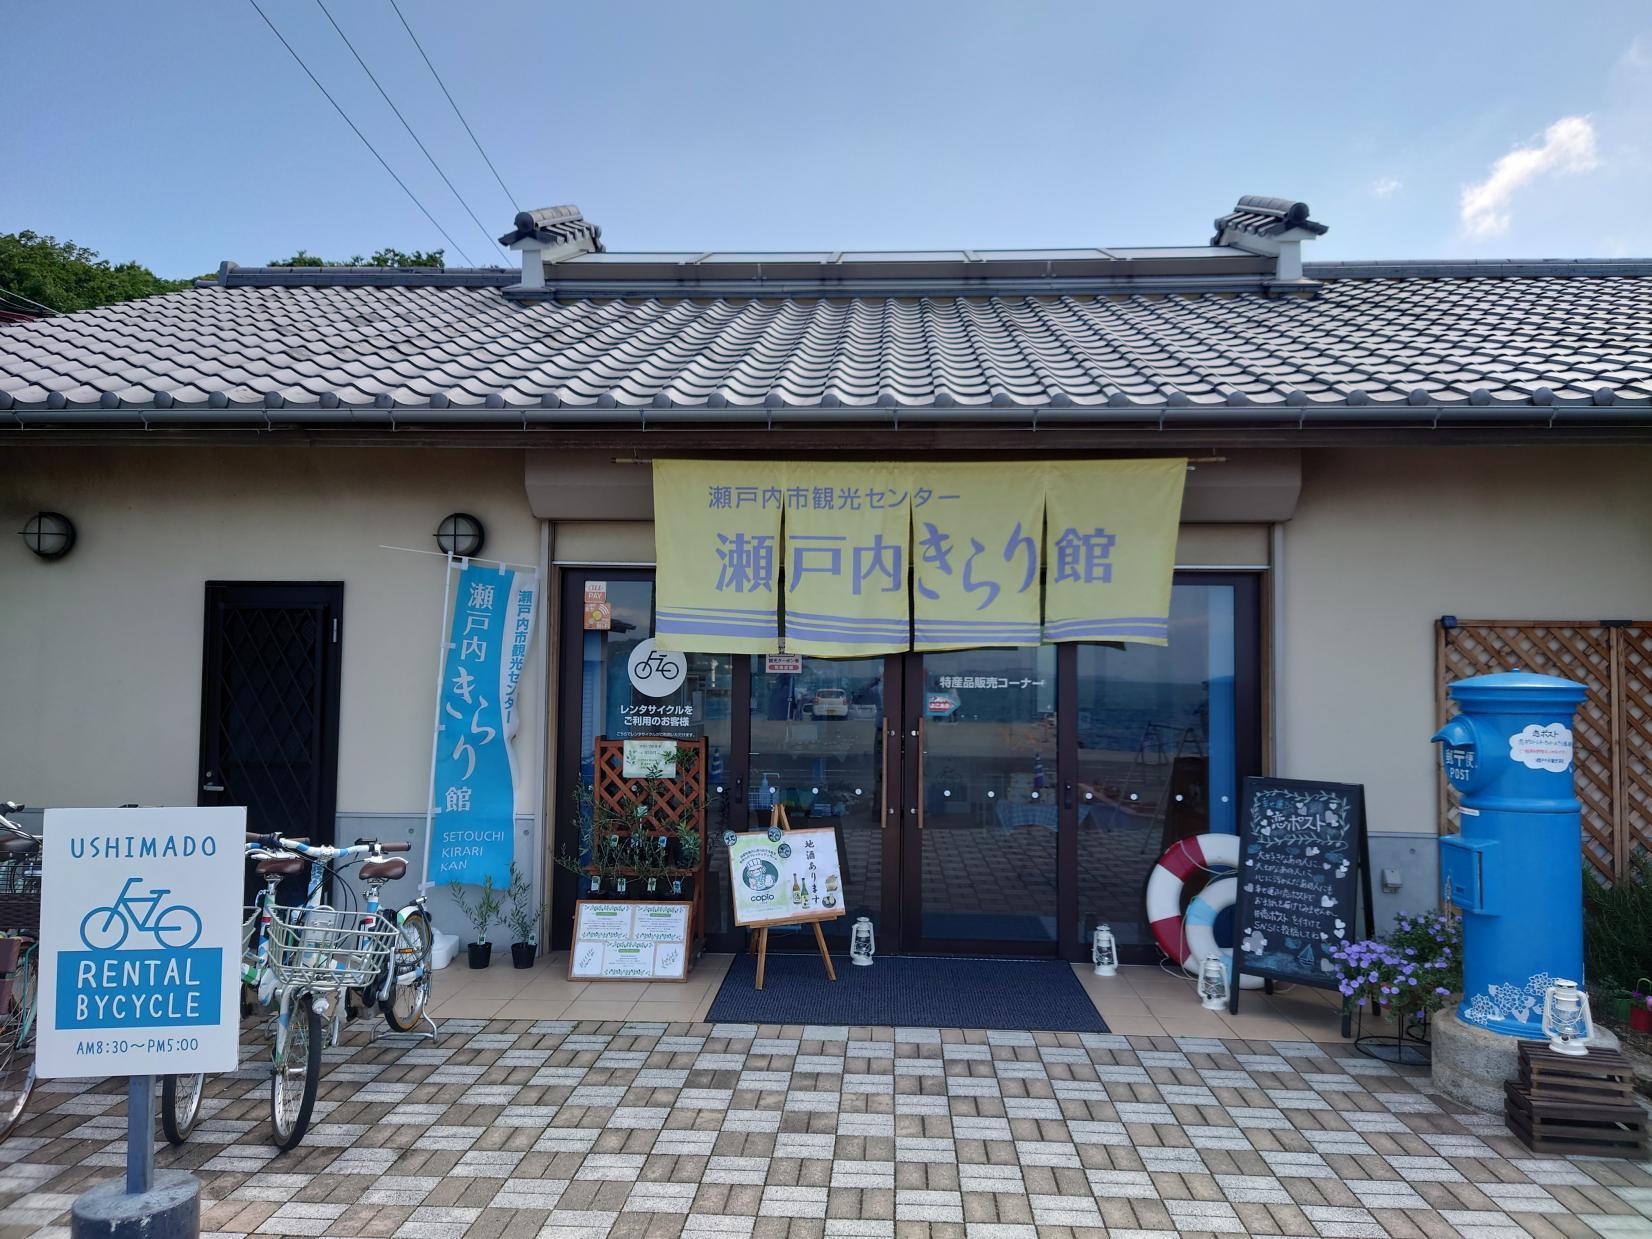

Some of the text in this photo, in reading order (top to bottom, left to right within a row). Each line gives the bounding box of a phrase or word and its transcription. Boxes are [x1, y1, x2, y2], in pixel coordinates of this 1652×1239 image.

[708, 486, 961, 510] 瀬戸内市観光センター
[715, 520, 1116, 611] 瀬戸内きらり館
[504, 590, 533, 724] 瀬戸内市観光センター
[939, 676, 1043, 689] 特産品販売コーナー
[446, 582, 496, 812] 瀬戸内きらり館
[620, 704, 693, 715] レンタサイクルを
[624, 716, 690, 727] ご利用のお客様
[1450, 767, 1470, 780] POST
[1271, 811, 1326, 832] 恋ポスト
[442, 830, 505, 842] SETOUCHI
[70, 836, 217, 858] USHIMADO
[441, 846, 483, 858] KIRARI
[440, 860, 467, 872] KAN
[804, 839, 820, 904] 地酒あります
[750, 892, 775, 902] copio
[77, 958, 201, 988] RENTAL
[76, 991, 201, 1021] BYCYCLE
